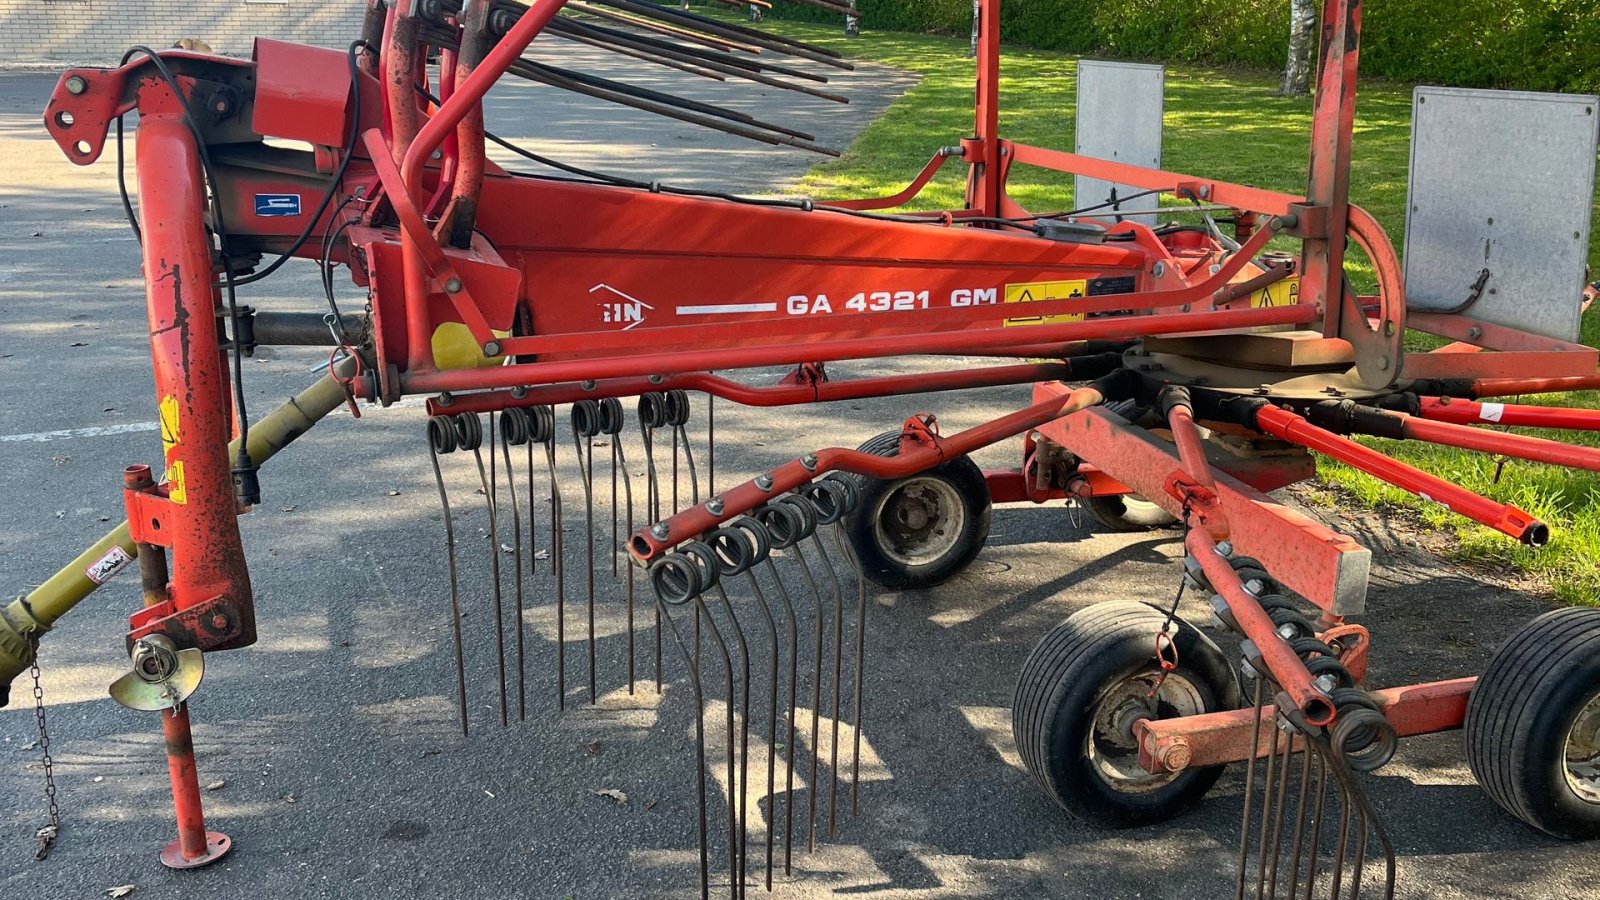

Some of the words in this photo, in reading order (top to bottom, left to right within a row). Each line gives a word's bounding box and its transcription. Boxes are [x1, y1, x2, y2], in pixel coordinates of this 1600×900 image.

[786, 294, 833, 315] GA
[845, 290, 930, 312] 4321
[950, 287, 998, 307] GM
